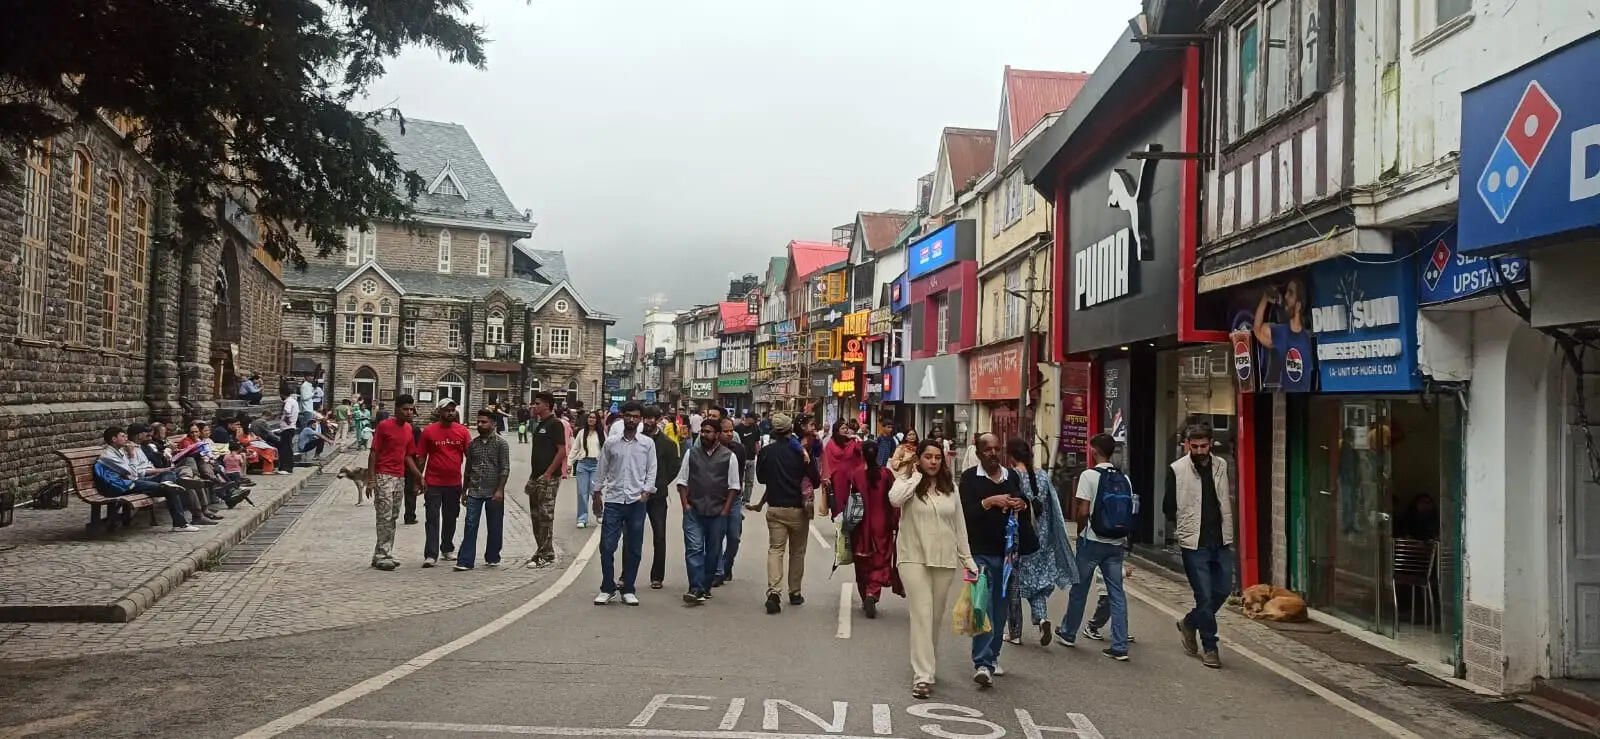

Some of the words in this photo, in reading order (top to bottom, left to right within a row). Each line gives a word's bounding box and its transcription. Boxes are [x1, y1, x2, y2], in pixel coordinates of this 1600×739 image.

[1075, 227, 1129, 311] PUMA
[1453, 261, 1519, 293] UPSTAIRS
[1312, 305, 1346, 333] DIM
[1352, 296, 1398, 328] SUM
[1350, 341, 1371, 359] FAST
[1371, 338, 1402, 358] FOOD
[1287, 359, 1302, 370] PEPSI
[1351, 366, 1359, 375] OF
[693, 382, 712, 391] OCTAVE
[628, 693, 1106, 739] FINISH
